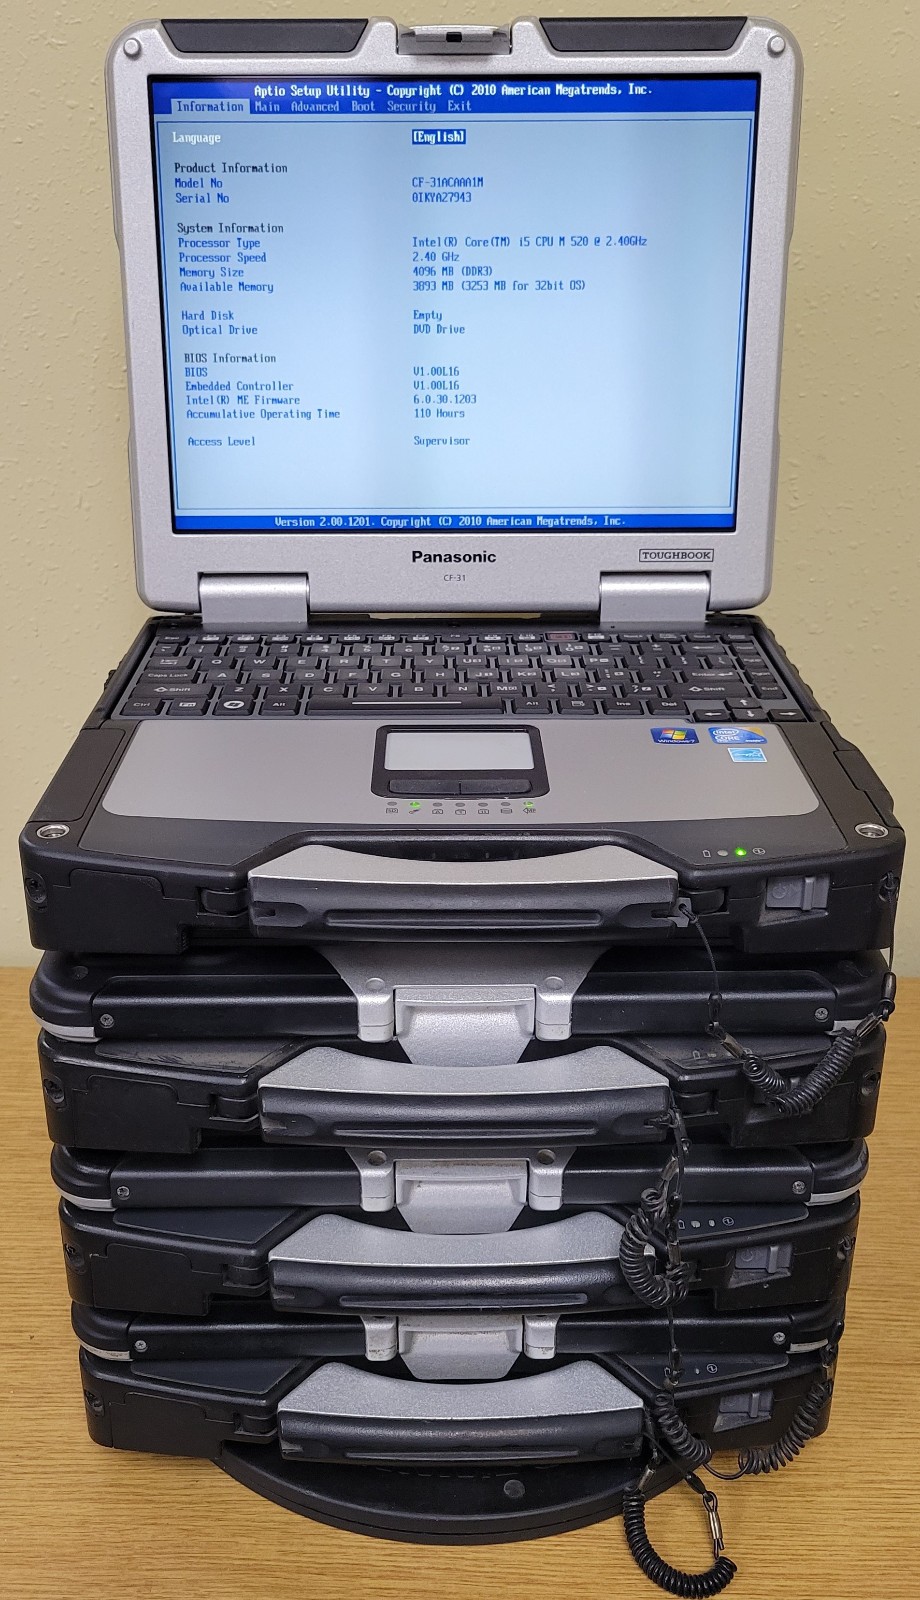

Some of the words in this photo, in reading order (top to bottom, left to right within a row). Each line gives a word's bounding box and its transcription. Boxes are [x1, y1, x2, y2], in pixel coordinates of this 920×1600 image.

[254, 85, 285, 97] Aptio
[291, 85, 322, 97] Setup
[326, 85, 370, 97] Utility
[387, 84, 442, 97] Copyright
[450, 84, 464, 96] (C)
[471, 85, 496, 96] 2010
[501, 84, 551, 96] American
[556, 84, 622, 97] Megatrends,
[628, 84, 652, 94] Inc.
[177, 101, 243, 111] Information
[255, 102, 280, 112] Main
[291, 101, 339, 111] Advanced
[352, 101, 375, 111] Boot
[387, 101, 436, 113] Security
[448, 101, 471, 112] Exit
[172, 132, 221, 145] Language
[413, 131, 465, 144] [English]
[175, 163, 216, 173] Product
[221, 163, 288, 173] Information
[175, 178, 204, 188] Model
[211, 178, 223, 188] No
[412, 177, 484, 188] CF-31ACAAA1M
[176, 193, 211, 203] Serial
[217, 193, 229, 203] No
[177, 223, 213, 235] System
[219, 223, 284, 233] Information
[178, 238, 230, 248] Processor
[237, 238, 261, 250] Type
[412, 236, 458, 248] Intel(R)
[465, 236, 510, 248] Core(TM)
[519, 237, 530, 247] i5
[536, 236, 554, 247] CPU
[559, 236, 565, 247] M
[571, 236, 589, 247] 520
[606, 236, 647, 247] 2.40GHz
[179, 253, 231, 263] Processor
[237, 253, 266, 264] Speed
[412, 252, 437, 263] 2.40
[442, 251, 460, 263] GHz
[179, 267, 215, 279] Memory
[221, 267, 244, 278] Size
[413, 267, 437, 277] 4096
[442, 266, 454, 277] MB
[461, 266, 493, 278] (DDR3)
[180, 282, 233, 293] Available
[238, 282, 274, 294] Memory
[413, 281, 437, 292] 3893
[442, 281, 454, 291] MB
[461, 280, 489, 292] (3253
[494, 280, 506, 291] MB
[512, 280, 529, 291] for
[535, 280, 564, 291] 32bit
[570, 280, 586, 291] OS)
[182, 311, 205, 321] Hard
[211, 311, 234, 321] Disk
[413, 310, 442, 322] Empty
[182, 325, 223, 337] Optical
[229, 325, 258, 335] Drive
[413, 324, 431, 335] DVD
[436, 324, 465, 335] Drive
[184, 353, 207, 363] BIOS
[213, 353, 276, 363] Information
[185, 367, 208, 377] BIOS
[413, 367, 459, 377] V1.00L16
[186, 381, 231, 392] Embedded
[237, 381, 294, 392] Controller
[413, 381, 459, 391] V1.00L16
[186, 395, 230, 406] Intel(R)
[237, 395, 249, 405] ME
[255, 395, 300, 405] Firmware
[413, 394, 477, 404] 6.0.30.1203
[186, 409, 255, 419] Accumulative
[260, 409, 312, 421] Operating
[318, 409, 340, 419] Time
[414, 409, 431, 419] 110
[436, 409, 465, 419] Hours
[188, 437, 222, 447] Access
[228, 437, 255, 447] Level
[414, 436, 470, 448] Supervisor
[275, 517, 315, 527] Version
[319, 517, 374, 527] 2.00.1201.
[381, 517, 431, 529] Copyright
[438, 516, 452, 527] (C)
[459, 516, 482, 526] 2010
[487, 516, 532, 526] American
[537, 516, 597, 527] Megatrends,
[604, 516, 625, 526] Inc.
[411, 550, 497, 563] Panasonic
[642, 550, 711, 560] TOUGHBOOK
[443, 574, 466, 582] CF-31
